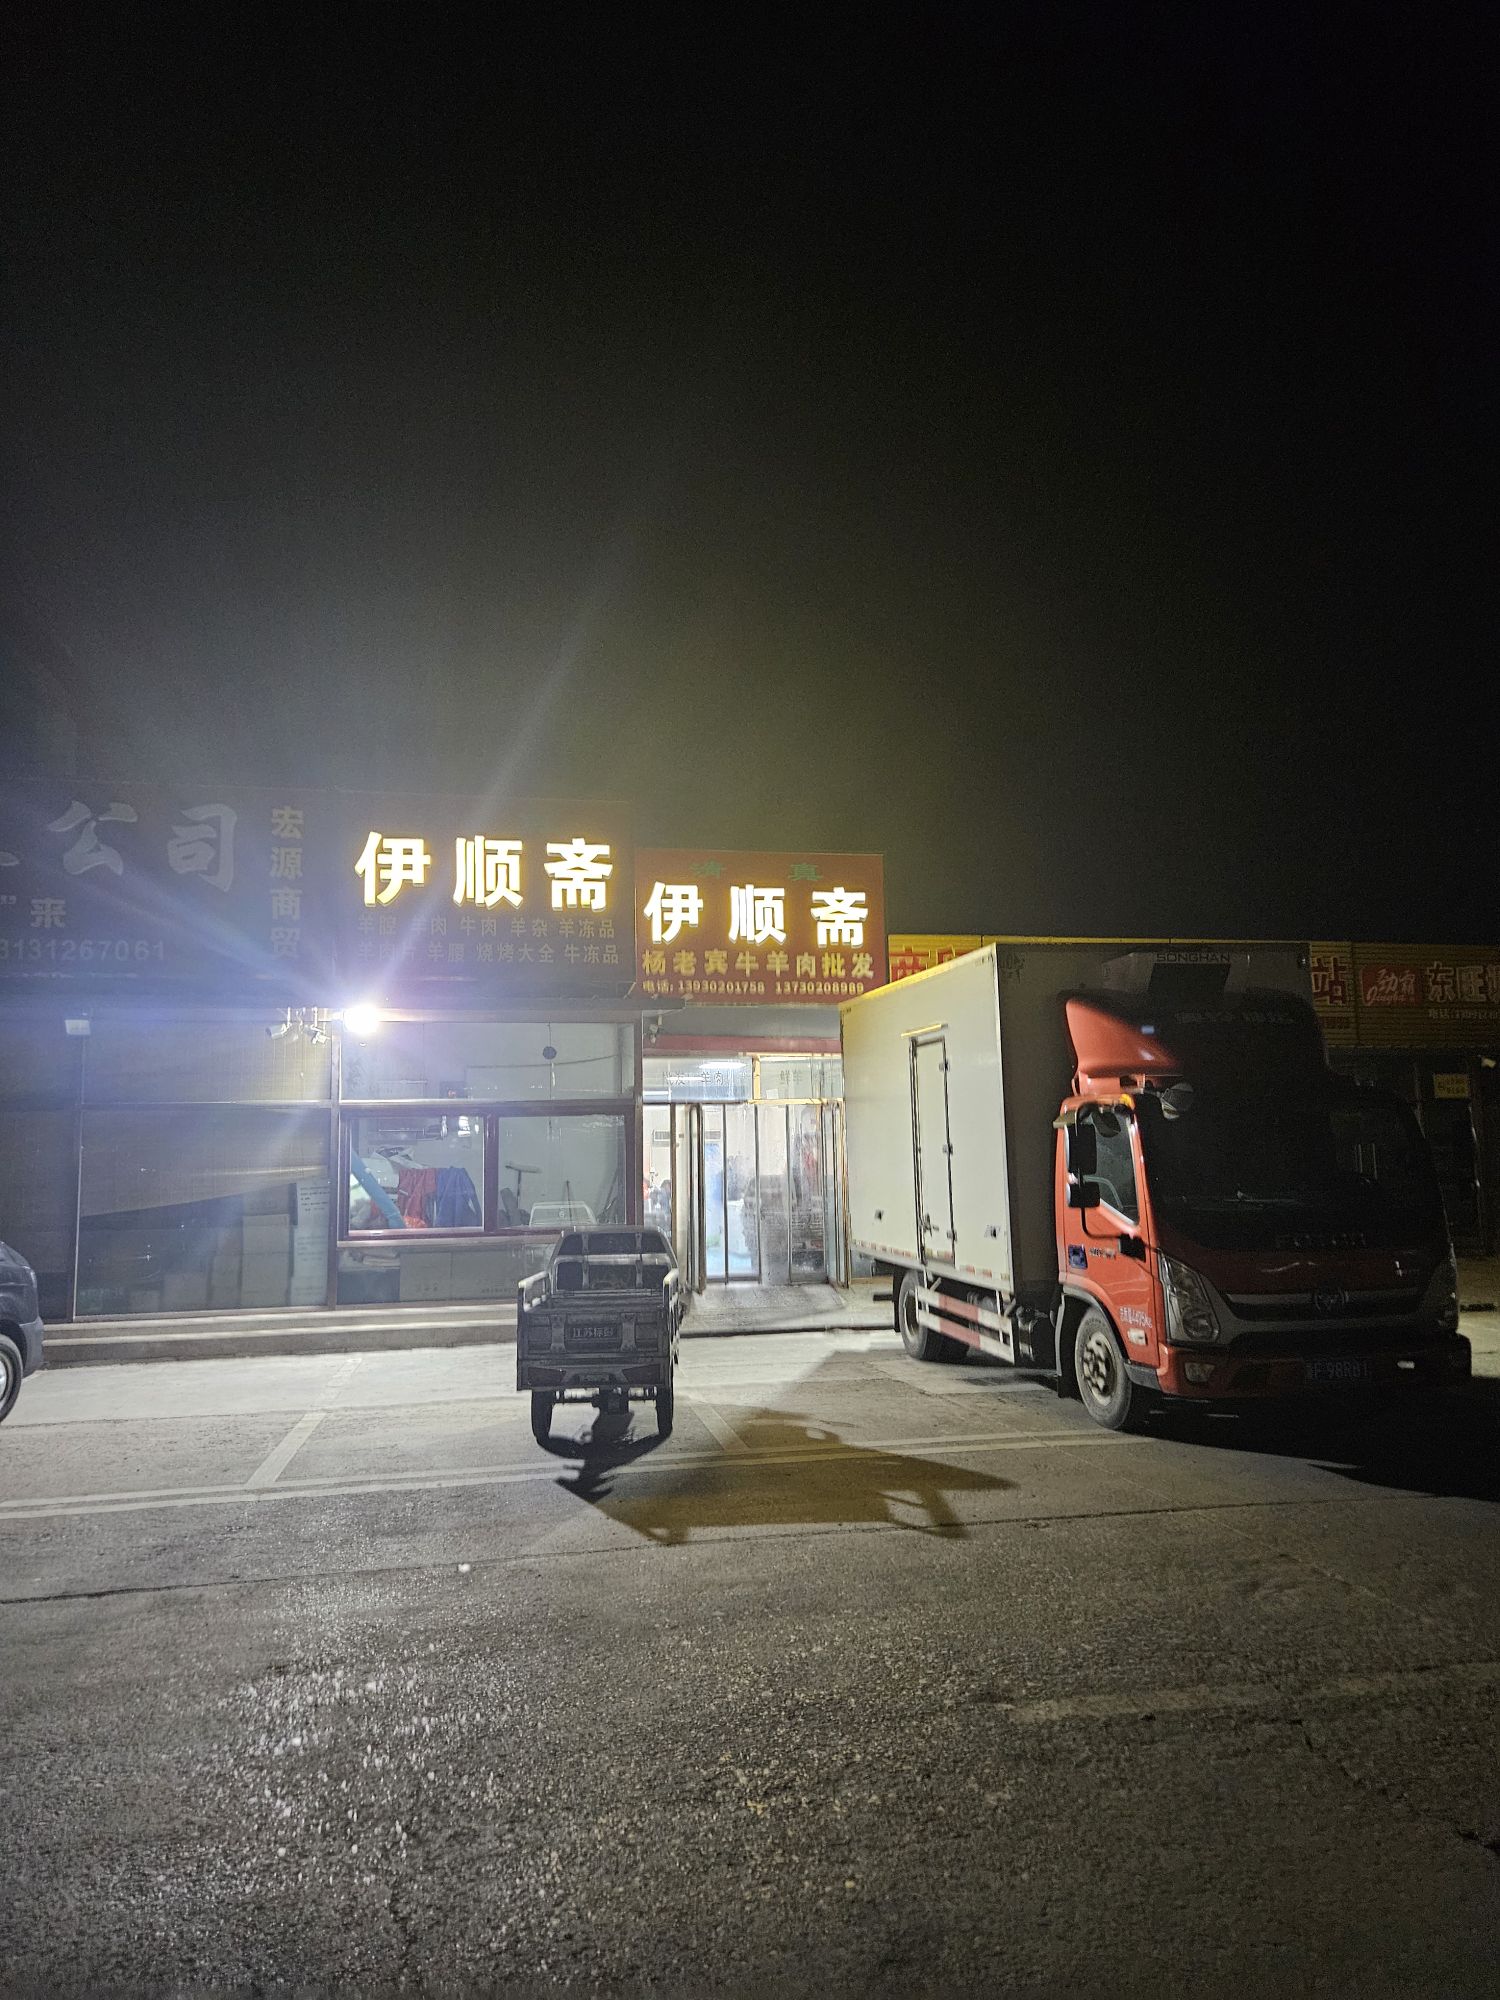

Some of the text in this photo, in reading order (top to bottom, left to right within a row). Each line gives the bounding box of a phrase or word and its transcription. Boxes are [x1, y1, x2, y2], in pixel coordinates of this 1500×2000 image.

[0, 801, 237, 892] 公司
[270, 805, 304, 959] 宏源商贸
[354, 831, 613, 912] 伊顺斋
[410, 913, 447, 936] 羊肉
[459, 917, 497, 937] 牛肉
[510, 917, 548, 938] 羊杂
[559, 917, 615, 938] 羊冻品
[643, 880, 869, 948] 伊顺斋
[476, 943, 554, 963] 烧烤大全
[564, 943, 619, 965] 牛冻品
